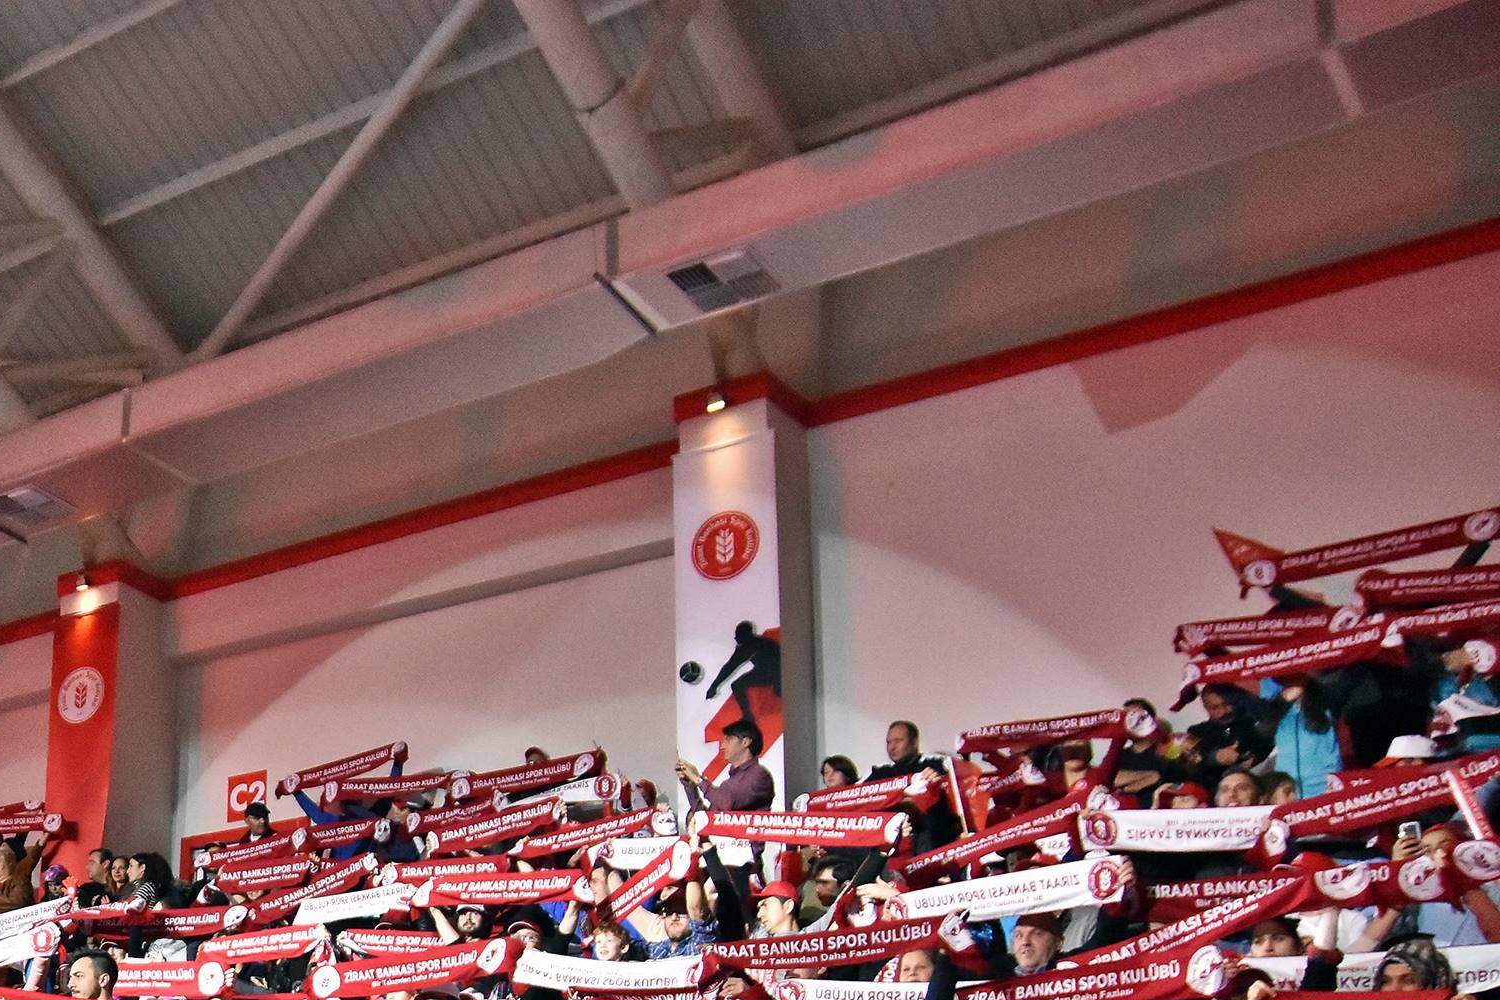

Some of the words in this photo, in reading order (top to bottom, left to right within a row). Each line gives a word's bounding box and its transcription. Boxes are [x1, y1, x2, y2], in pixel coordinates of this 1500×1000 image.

[1438, 757, 1499, 789] KLÜBÜ
[230, 780, 265, 812] C2
[759, 939, 824, 957] BANKASI
[828, 934, 867, 950] SPOR
[872, 924, 932, 945] KULÜBÜ
[1139, 918, 1202, 950] BANKASI
[1204, 898, 1244, 924] SPOR
[1015, 978, 1076, 998] BANKASI
[1079, 971, 1118, 990] SPOR
[1119, 959, 1180, 985] KULÜBÜ
